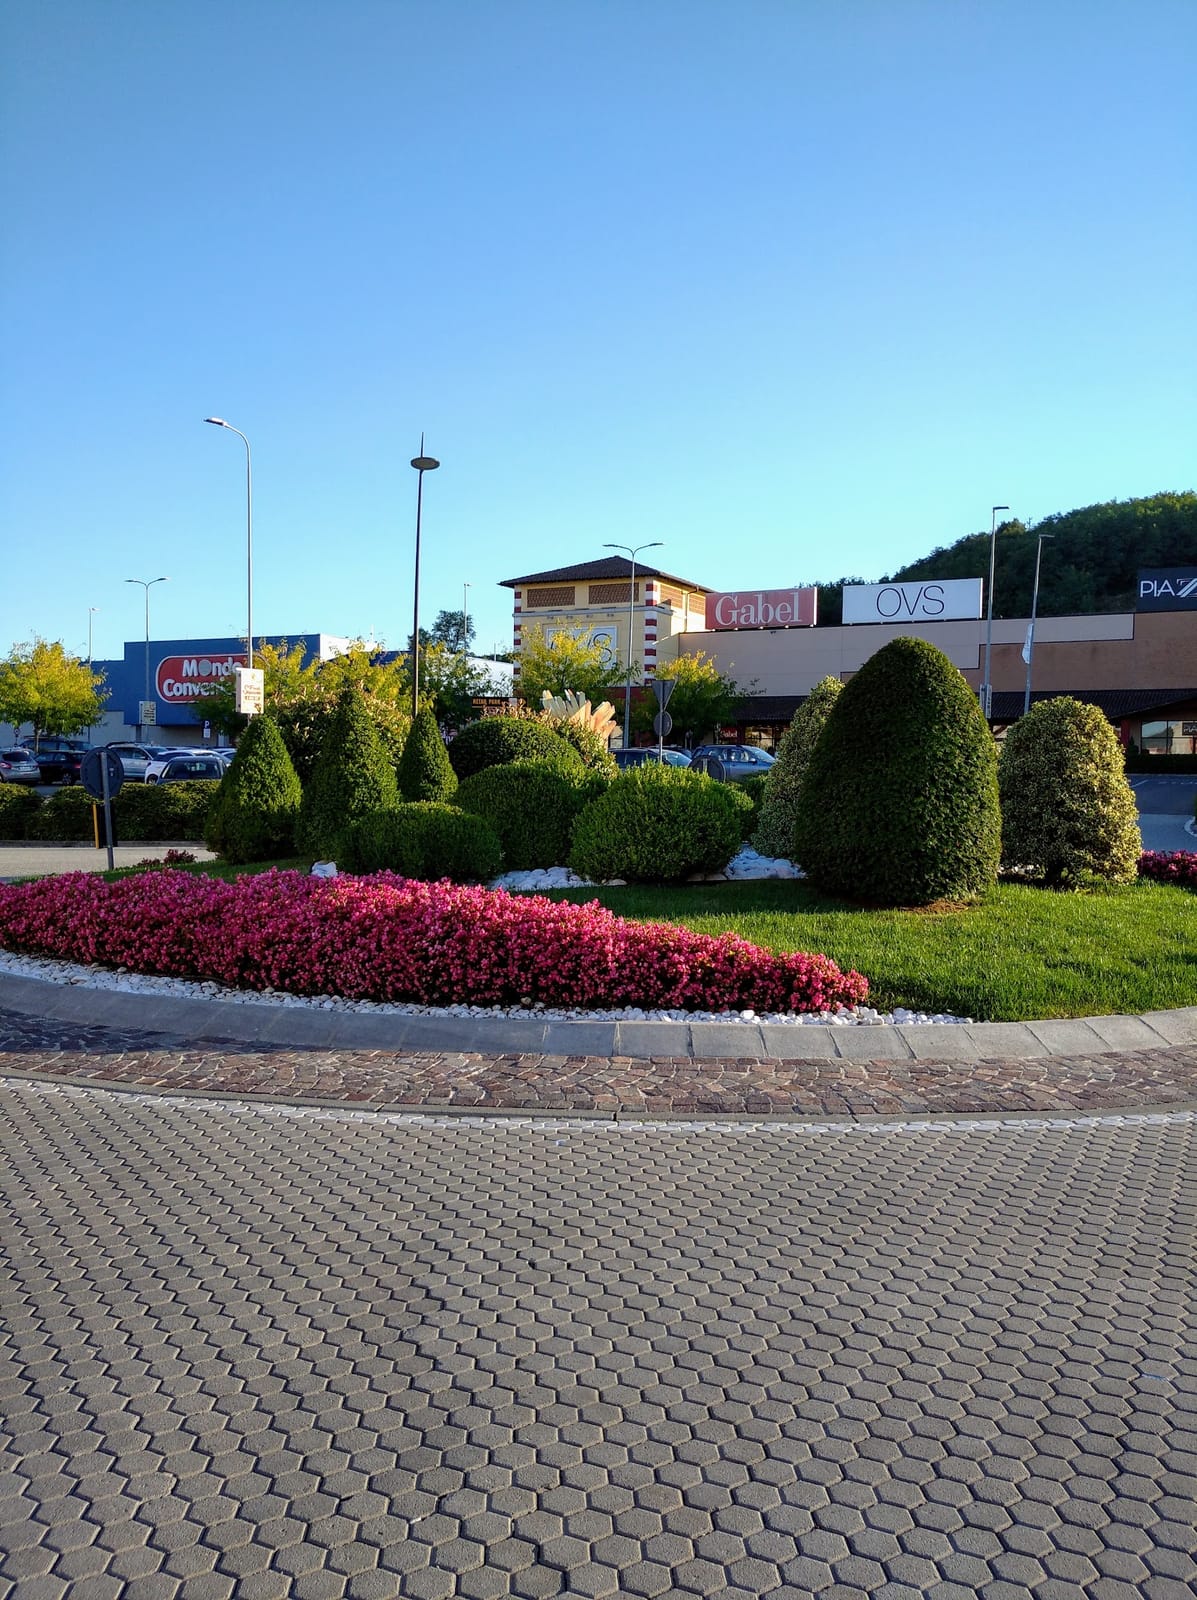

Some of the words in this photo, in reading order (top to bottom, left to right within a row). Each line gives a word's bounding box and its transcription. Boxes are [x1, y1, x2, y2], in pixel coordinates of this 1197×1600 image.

[714, 592, 802, 626] Gabel
[876, 585, 945, 617] OVS
[204, 720, 210, 729] P
